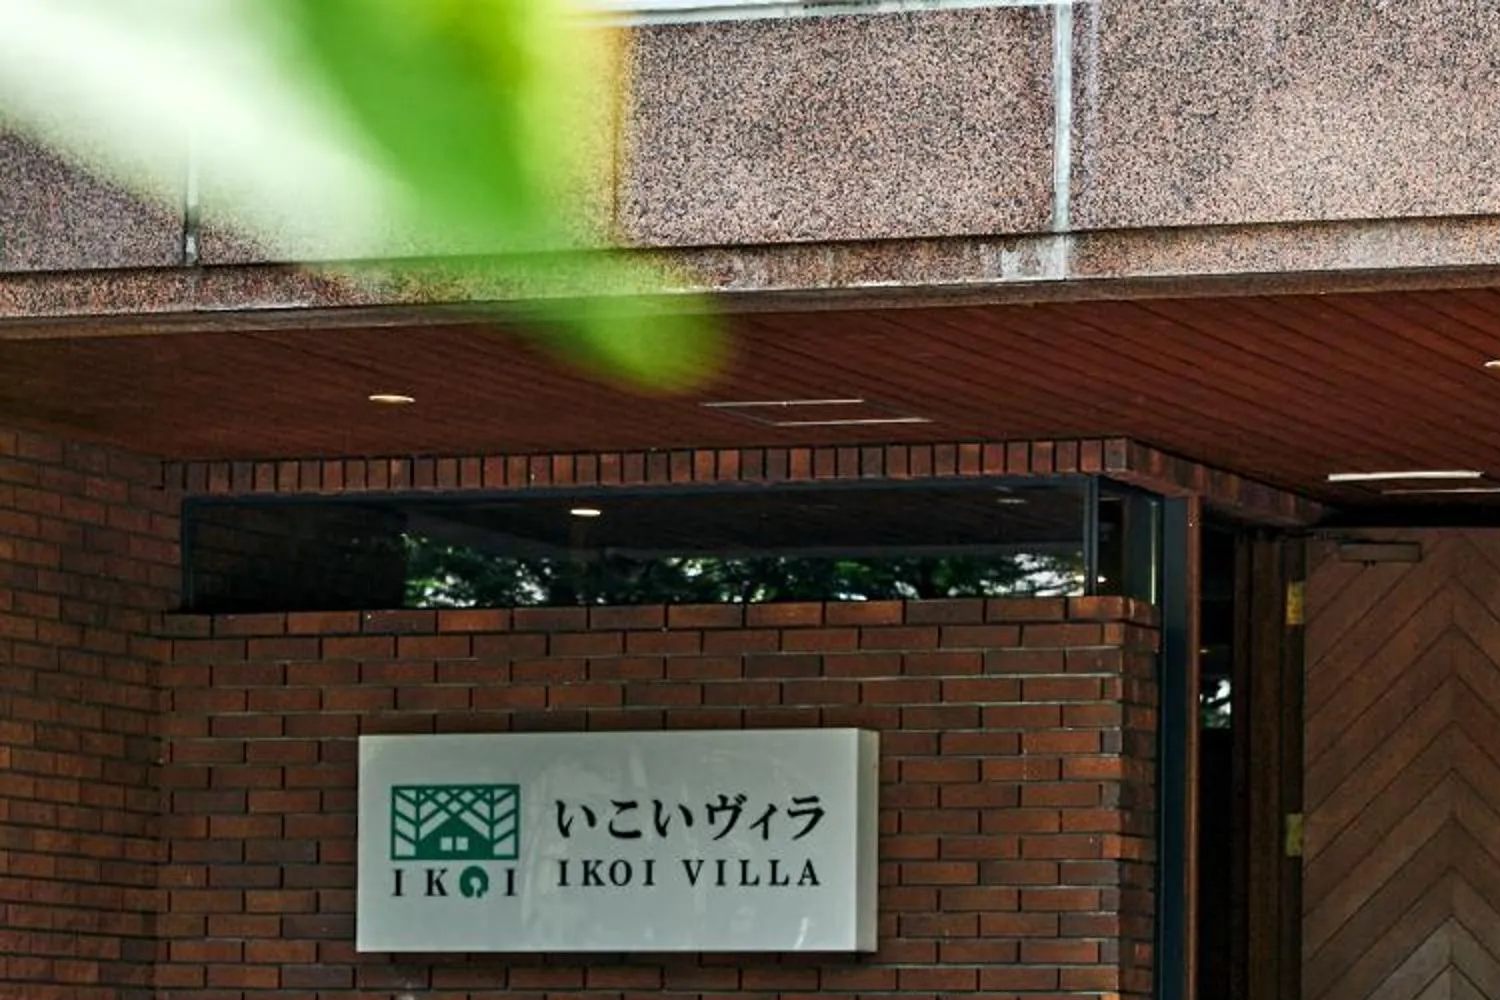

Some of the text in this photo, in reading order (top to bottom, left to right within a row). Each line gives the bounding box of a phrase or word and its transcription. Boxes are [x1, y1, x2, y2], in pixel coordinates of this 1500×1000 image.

[554, 793, 827, 840] いこいヴィラ
[557, 858, 821, 887] IKOI VILLA
